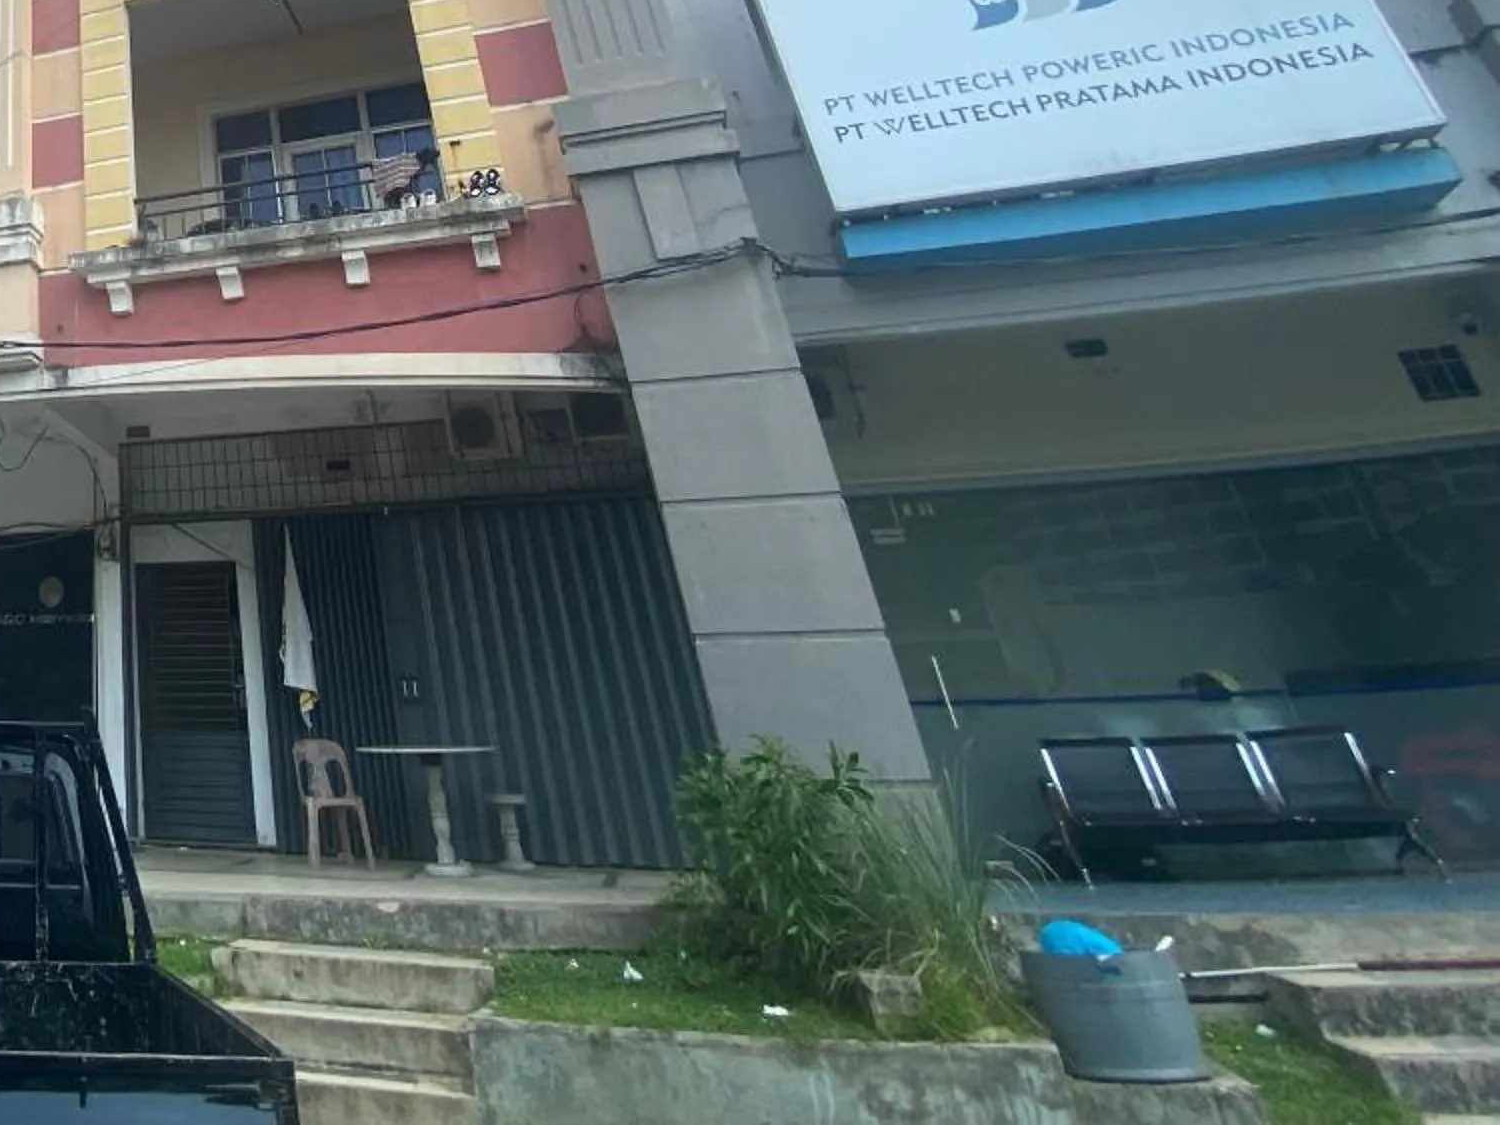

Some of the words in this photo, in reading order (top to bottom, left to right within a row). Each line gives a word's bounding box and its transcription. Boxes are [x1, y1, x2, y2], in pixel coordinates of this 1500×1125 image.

[823, 93, 856, 116] PT
[863, 67, 1016, 108] WELLTECH
[1021, 43, 1166, 83] POWERIC
[1169, 11, 1355, 58] INDONESIA
[833, 121, 866, 144] PT
[872, 96, 1032, 137] WELLTECH
[1035, 74, 1183, 112] PRATAMA
[1186, 41, 1375, 89] INDONESIA
